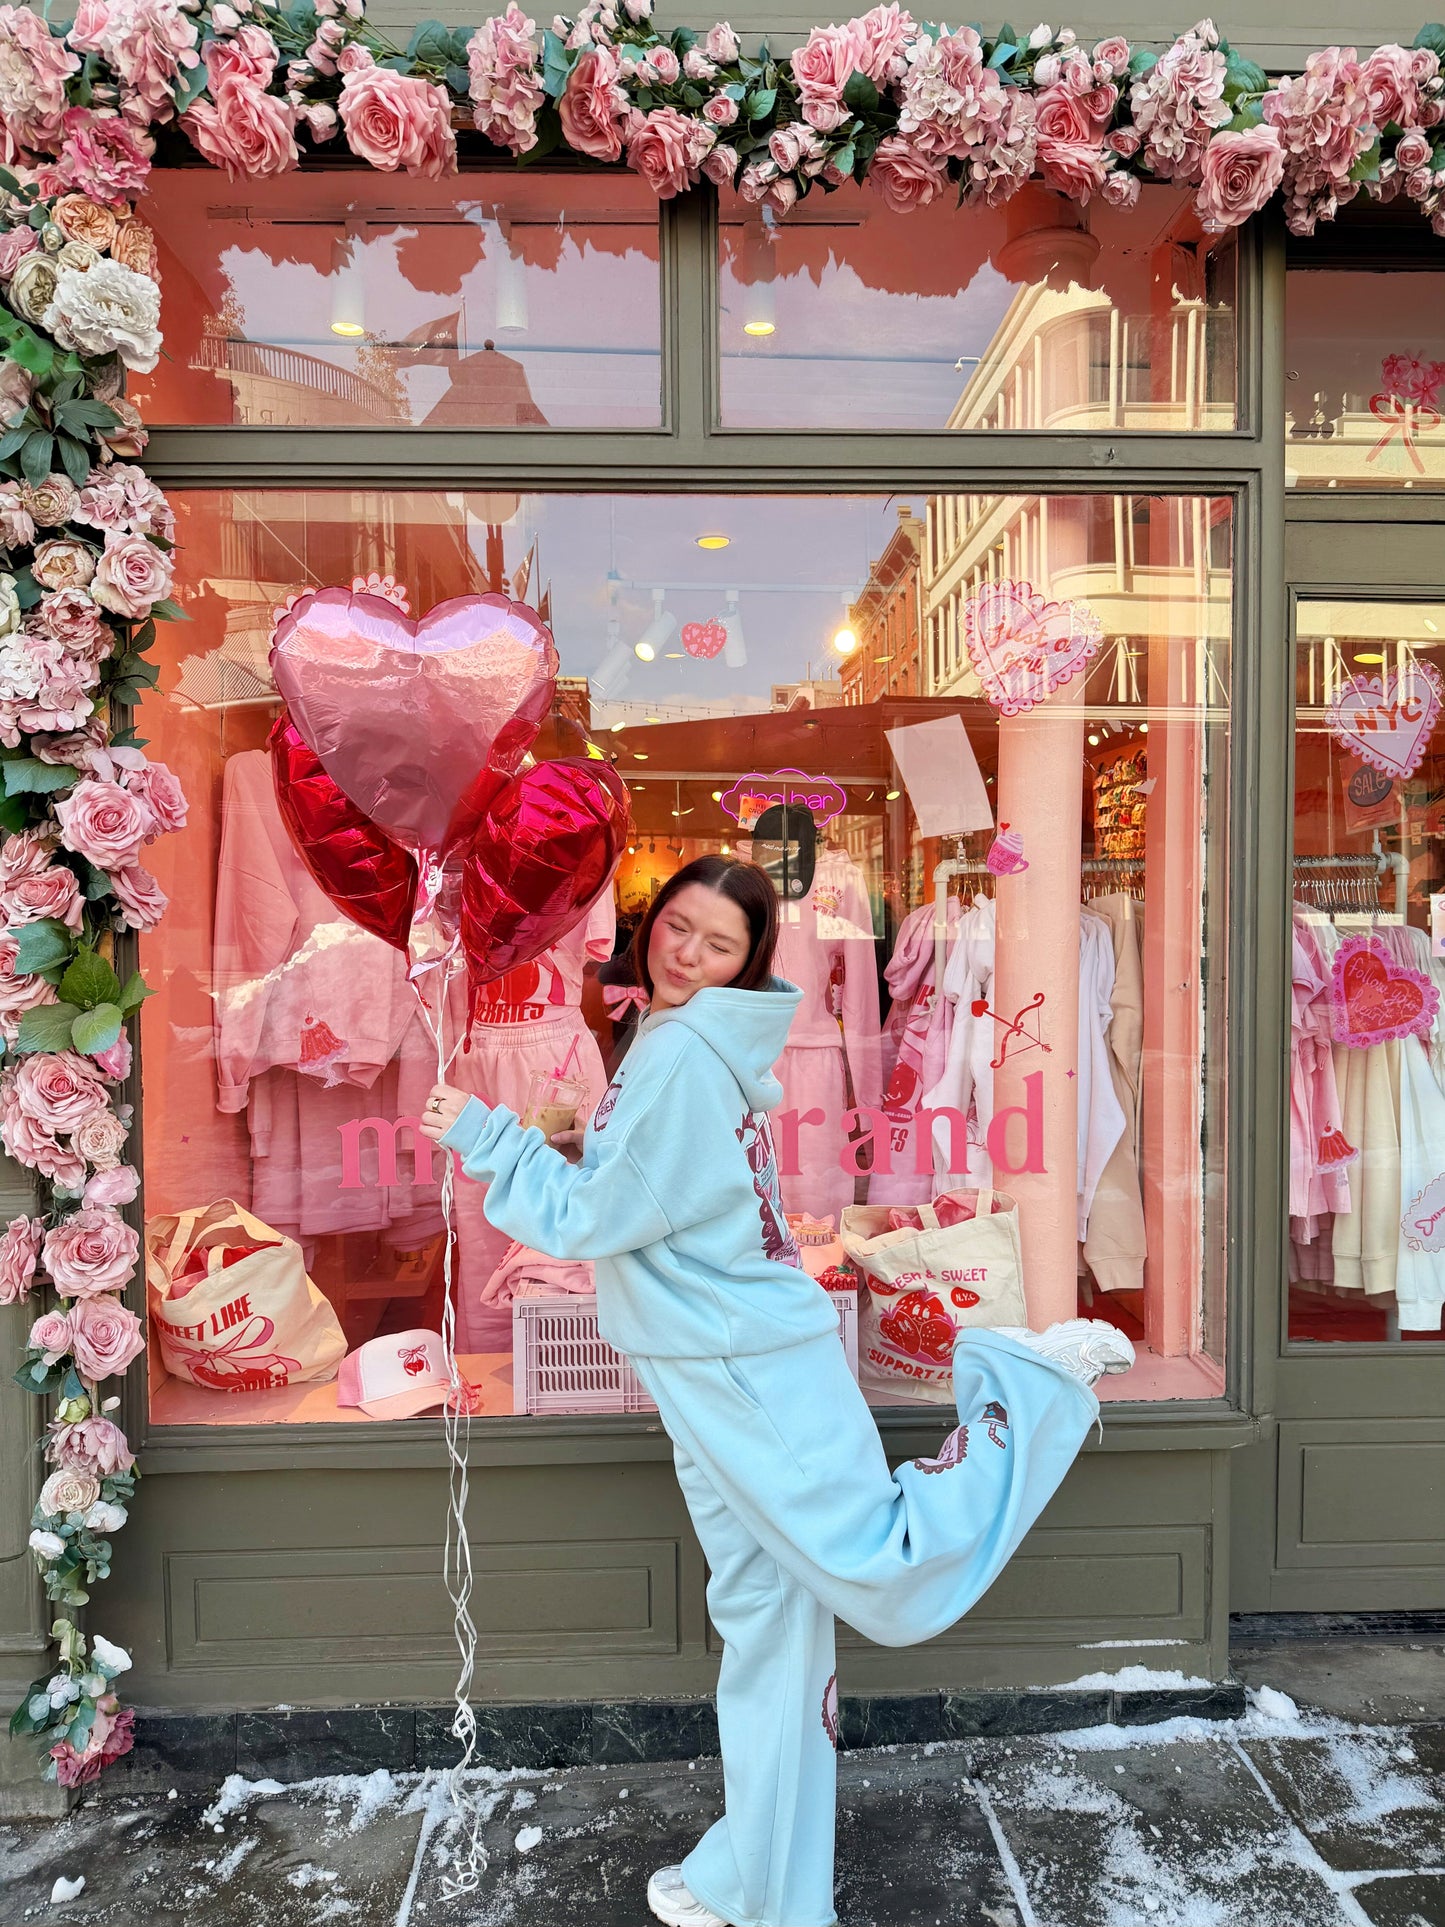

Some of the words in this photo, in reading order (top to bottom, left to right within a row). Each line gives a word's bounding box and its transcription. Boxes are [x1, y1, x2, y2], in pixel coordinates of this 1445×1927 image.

[988, 614, 1049, 648] just
[1053, 637, 1071, 652] a
[1354, 696, 1423, 737] NYC
[1348, 957, 1389, 993] follow
[1350, 989, 1390, 1026] heart
[777, 1071, 1049, 1176] rand
[925, 1269, 937, 1280] &
[941, 1268, 988, 1282] SWEET
[210, 1292, 254, 1337] LIKE
